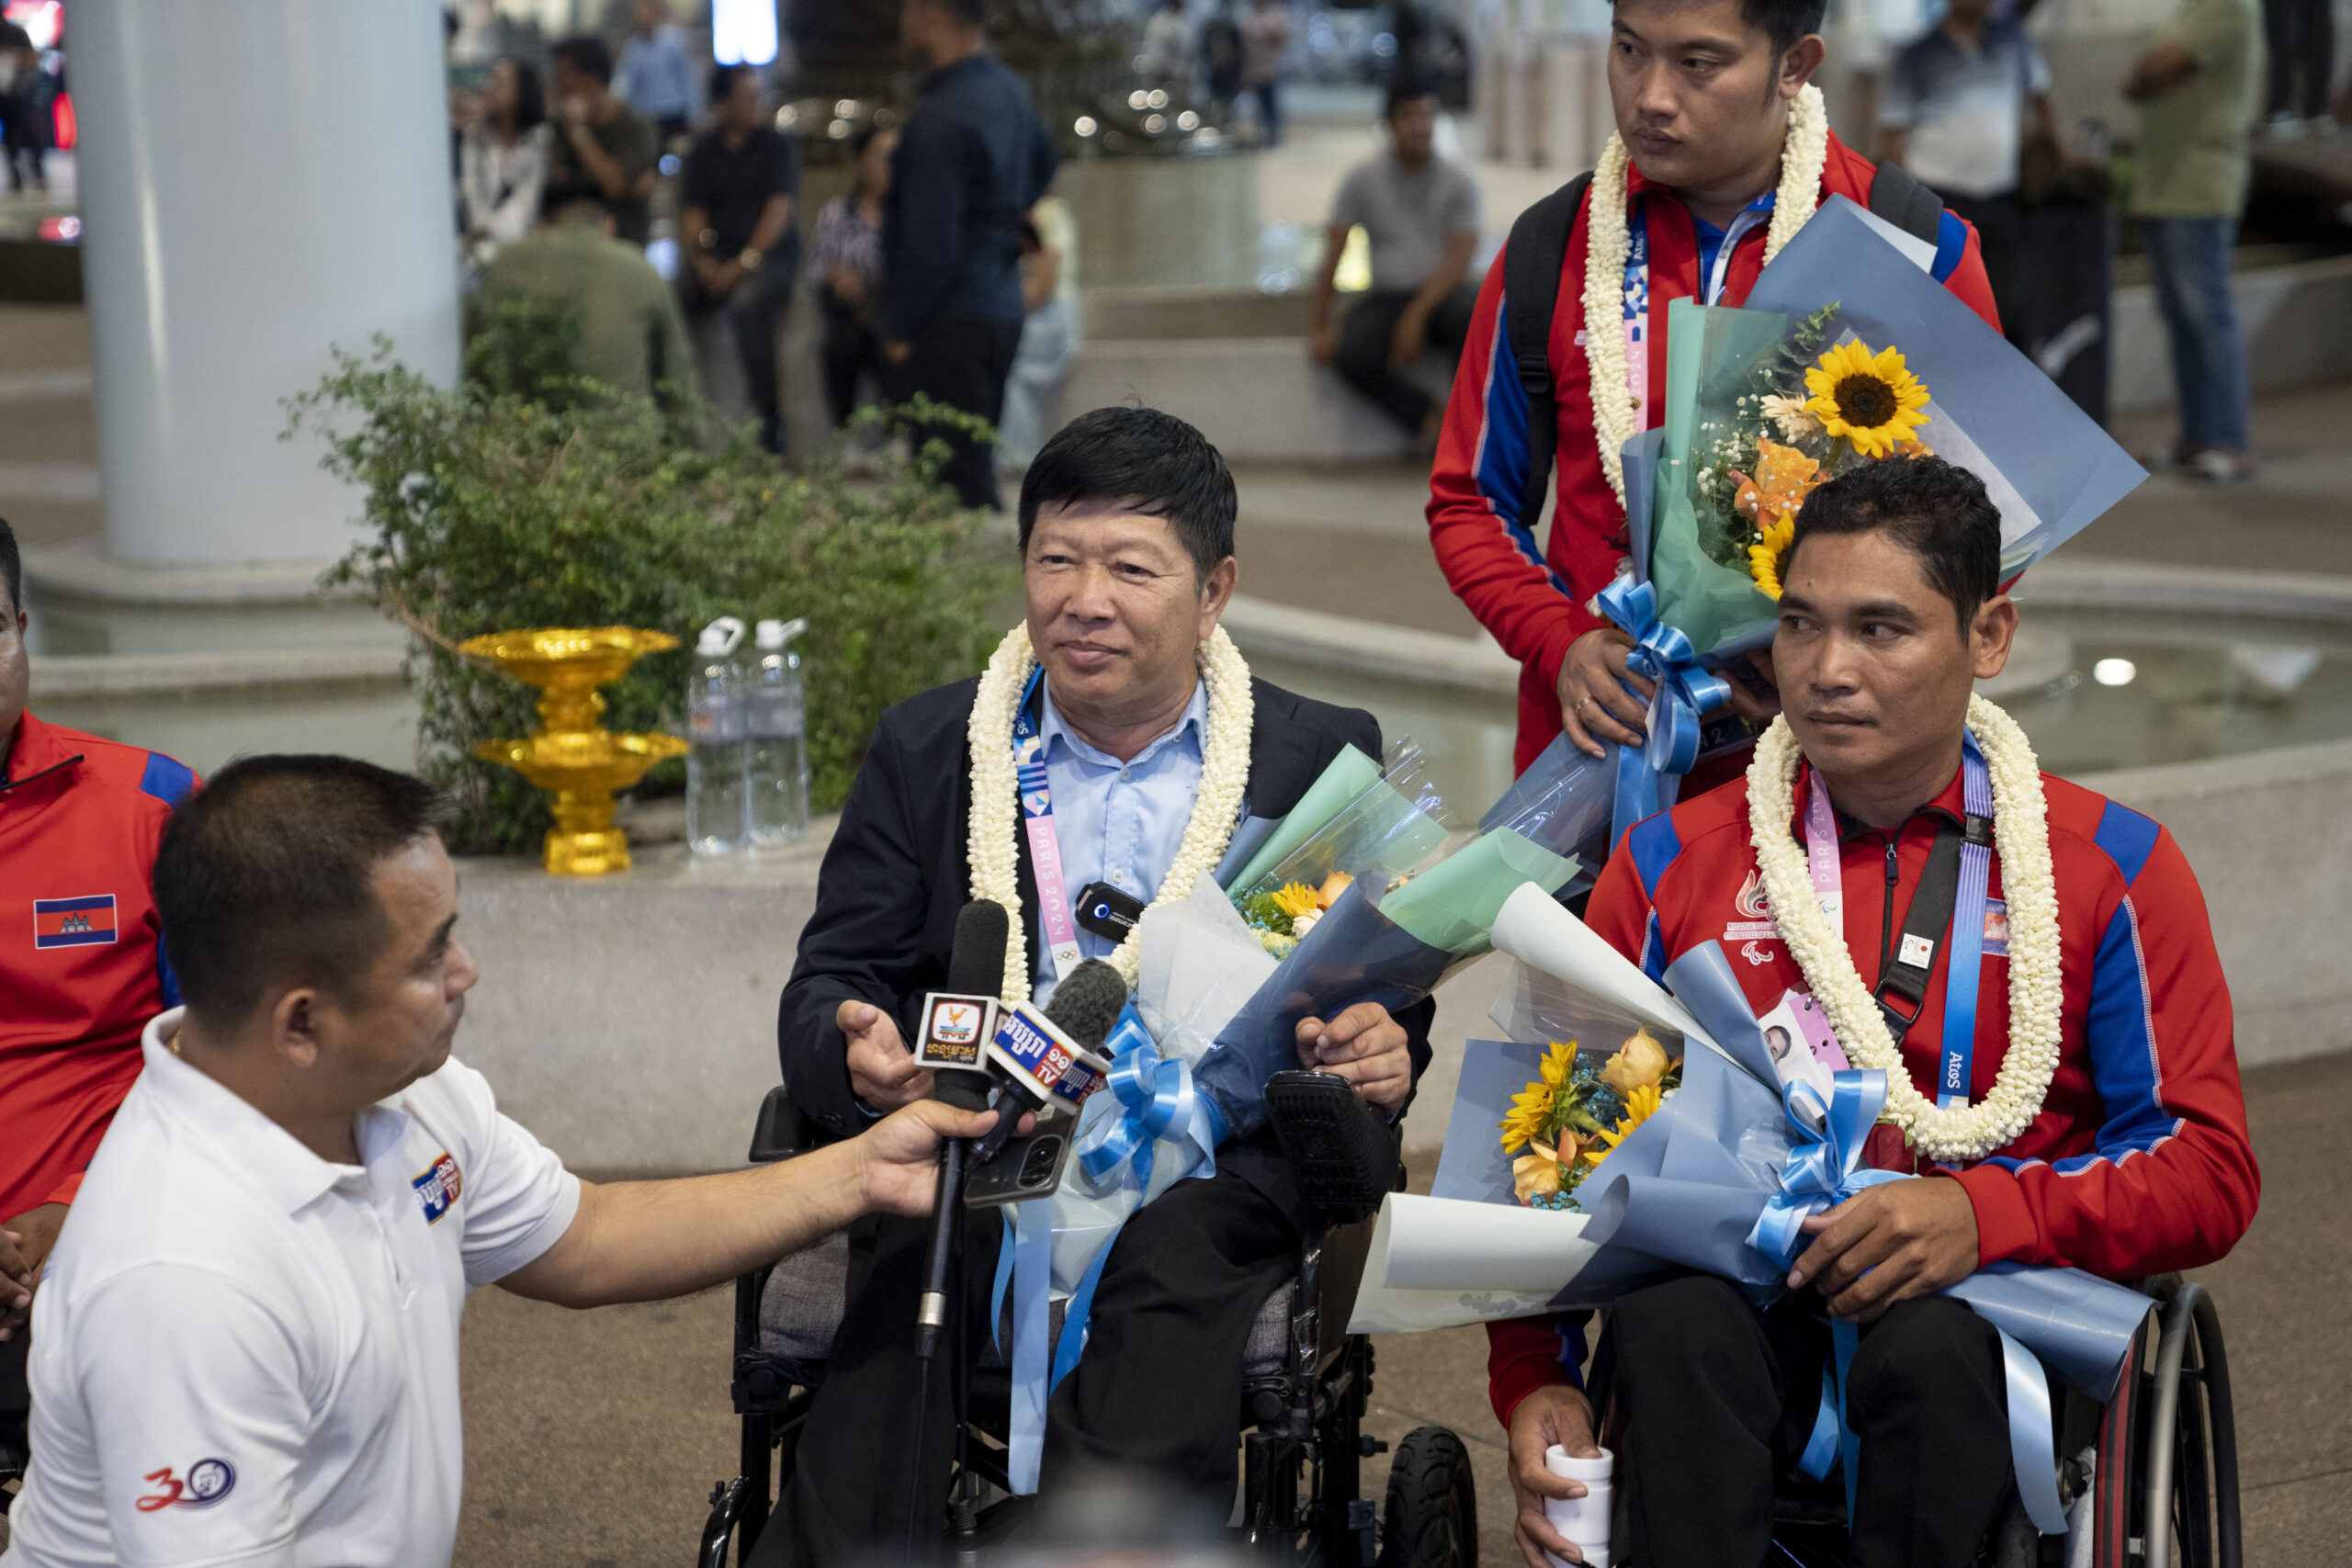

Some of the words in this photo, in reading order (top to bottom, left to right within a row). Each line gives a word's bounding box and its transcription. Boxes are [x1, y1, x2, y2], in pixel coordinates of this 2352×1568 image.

[1815, 829, 1832, 883] PARIS
[1035, 827, 1055, 880] PARIS
[1046, 886, 1065, 935] 2024
[1036, 1066, 1057, 1085] TV
[1947, 1050, 1963, 1089] Atos
